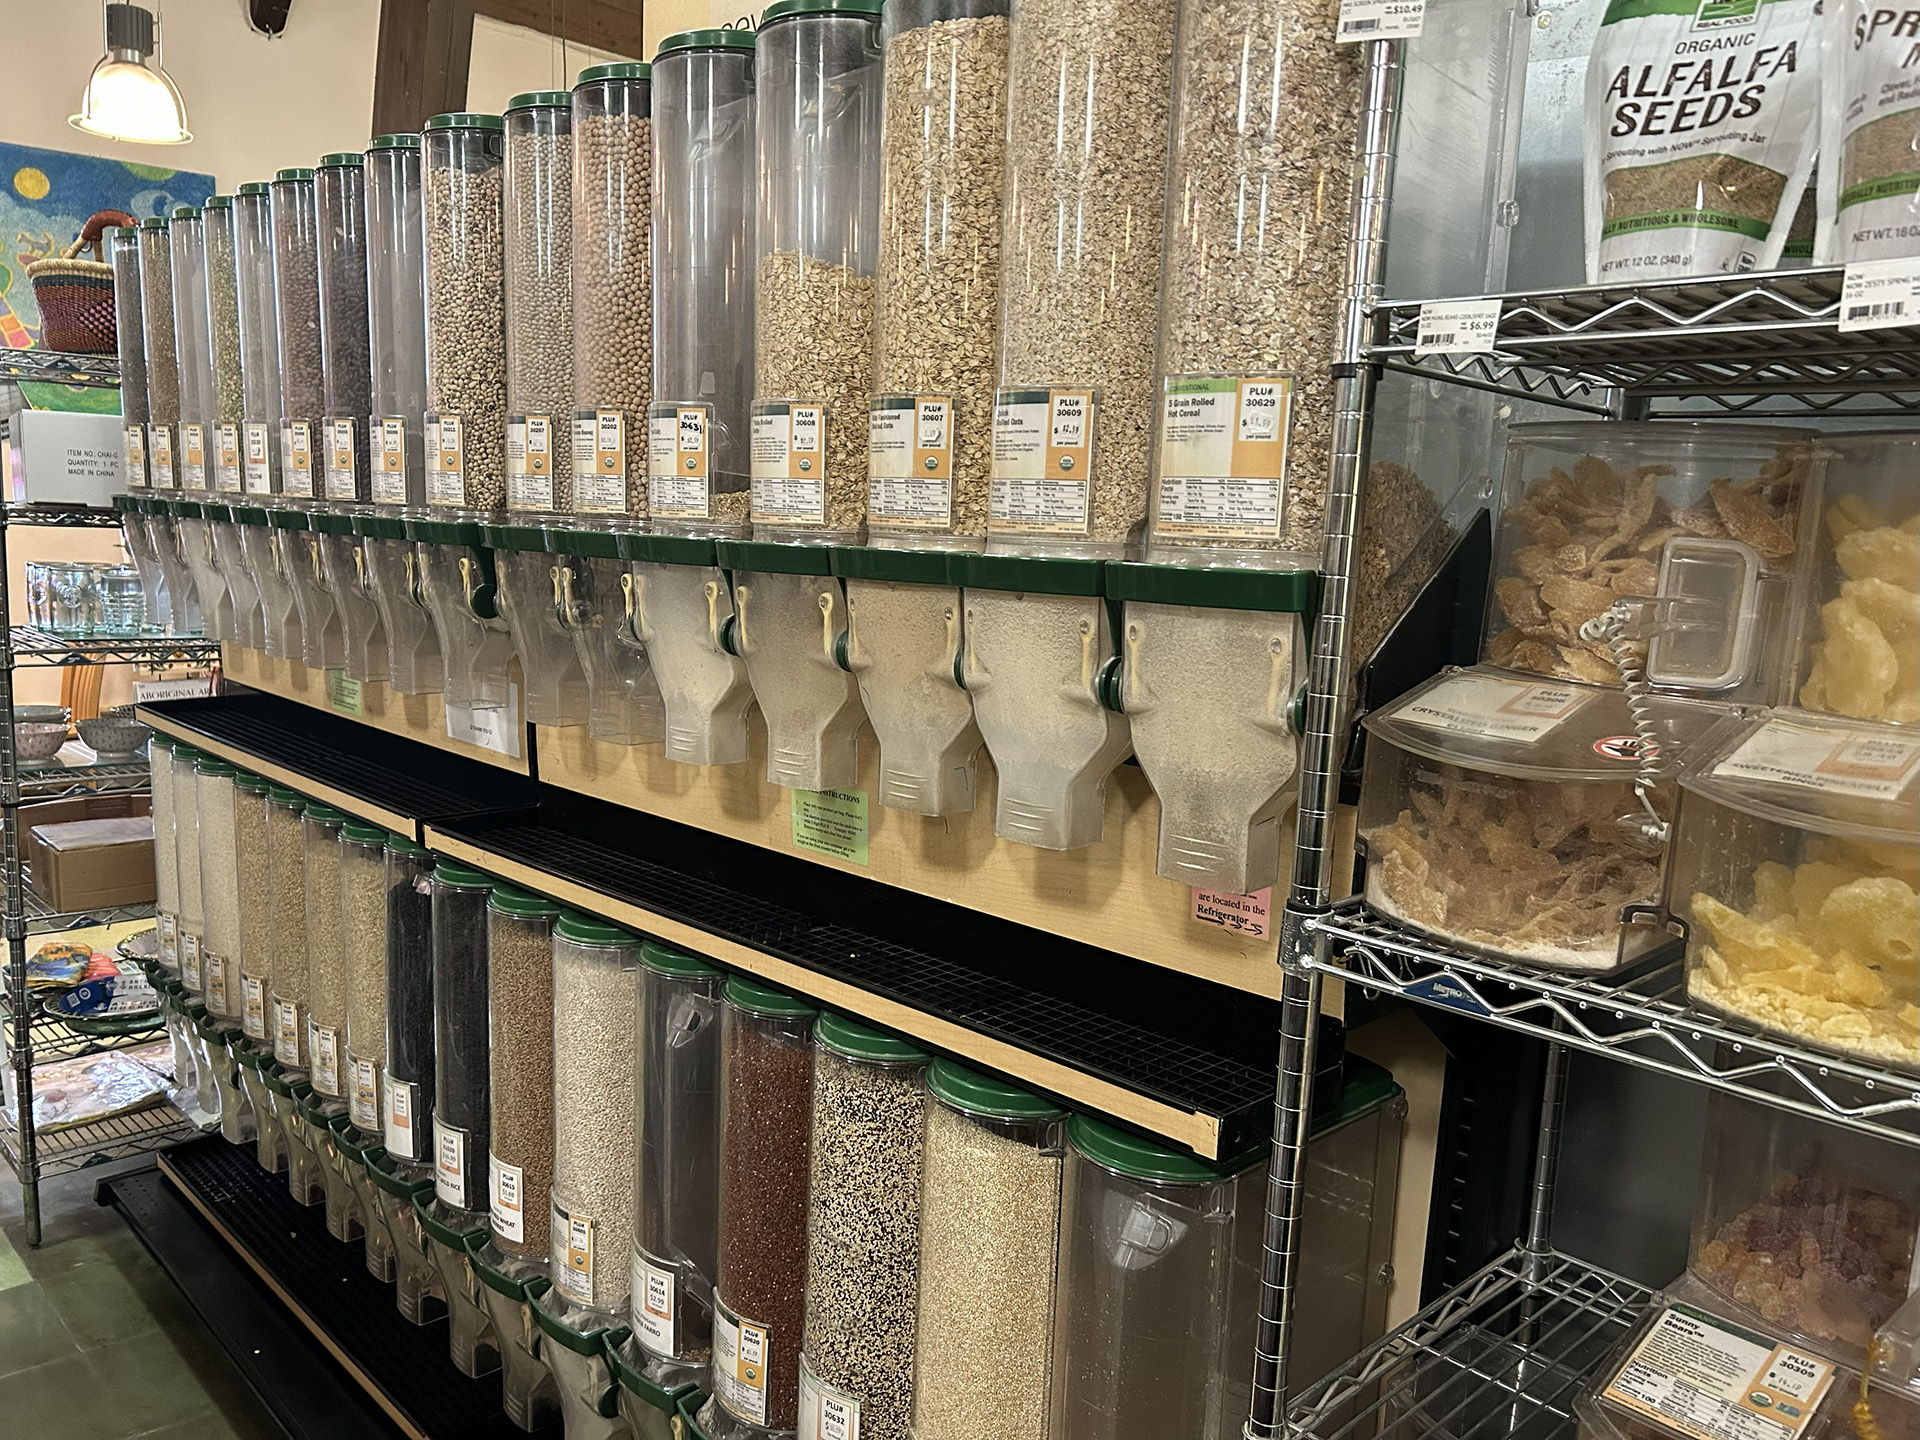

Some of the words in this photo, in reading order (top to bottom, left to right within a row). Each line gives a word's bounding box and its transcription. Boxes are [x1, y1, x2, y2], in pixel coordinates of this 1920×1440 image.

[1675, 33, 1756, 54] ORGANIC
[1605, 41, 1798, 103] ALFALFA
[1611, 84, 1766, 137] SEEDS
[1606, 147, 1646, 163] Sprouting
[1701, 132, 1748, 147] Sprouting
[1749, 132, 1767, 144] Jar
[1618, 215, 1670, 231] NUTRITIOUS
[1671, 213, 1680, 224] &
[1682, 213, 1740, 229] WHOLESOME
[1852, 230, 1872, 243] NET
[1616, 258, 1630, 270] WT.
[1632, 256, 1643, 267] 12
[1644, 256, 1659, 266] OZ.
[1660, 254, 1681, 266] (340
[1682, 254, 1693, 267] g)
[1470, 321, 1494, 331] $6.99
[1249, 387, 1273, 395] PLU#
[1168, 399, 1173, 408] 5
[1174, 398, 1190, 407] Grain
[1191, 397, 1215, 407] Rolled
[1245, 398, 1276, 407] 30629
[1056, 409, 1082, 417] 30609
[1168, 409, 1178, 418] Hot
[1179, 408, 1201, 418] Cereal
[1010, 418, 1023, 426] Oats
[1242, 418, 1247, 427] $
[67, 449, 82, 457] ITEM
[97, 451, 118, 459] CHAI-G
[67, 458, 100, 467] QUANTITY:
[67, 468, 85, 476] MADE
[96, 469, 115, 477] CHINA
[140, 688, 194, 700] ABORIGINAL
[199, 687, 213, 696] AR
[1412, 706, 1487, 727] CRYSTALIZED
[1489, 722, 1539, 732] GINGER
[1732, 762, 1812, 779] SWEETENED
[1782, 775, 1824, 787] RINGS
[1198, 892, 1211, 902] are
[1212, 894, 1241, 910] located
[1242, 901, 1251, 912] in
[1252, 904, 1266, 916] the
[1197, 903, 1250, 925] Refrigerator
[1432, 982, 1463, 997] METRO
[451, 1182, 461, 1192] RICE
[500, 1216, 516, 1228] WHEAT
[650, 1276, 664, 1286] PLU#
[1668, 1313, 1701, 1331] Sunny
[1677, 1306, 1719, 1326] ORGANIC
[643, 1323, 661, 1337] FARRO
[1779, 1360, 1815, 1378] 30309
[1787, 1354, 1816, 1370] PLU#
[1629, 1364, 1652, 1378] Facts
[1632, 1360, 1668, 1380] Nutrition
[1641, 1393, 1656, 1404] 100
[1779, 1388, 1798, 1398] pound
[826, 1399, 844, 1413] PLU#
[823, 1409, 845, 1426] 30632
